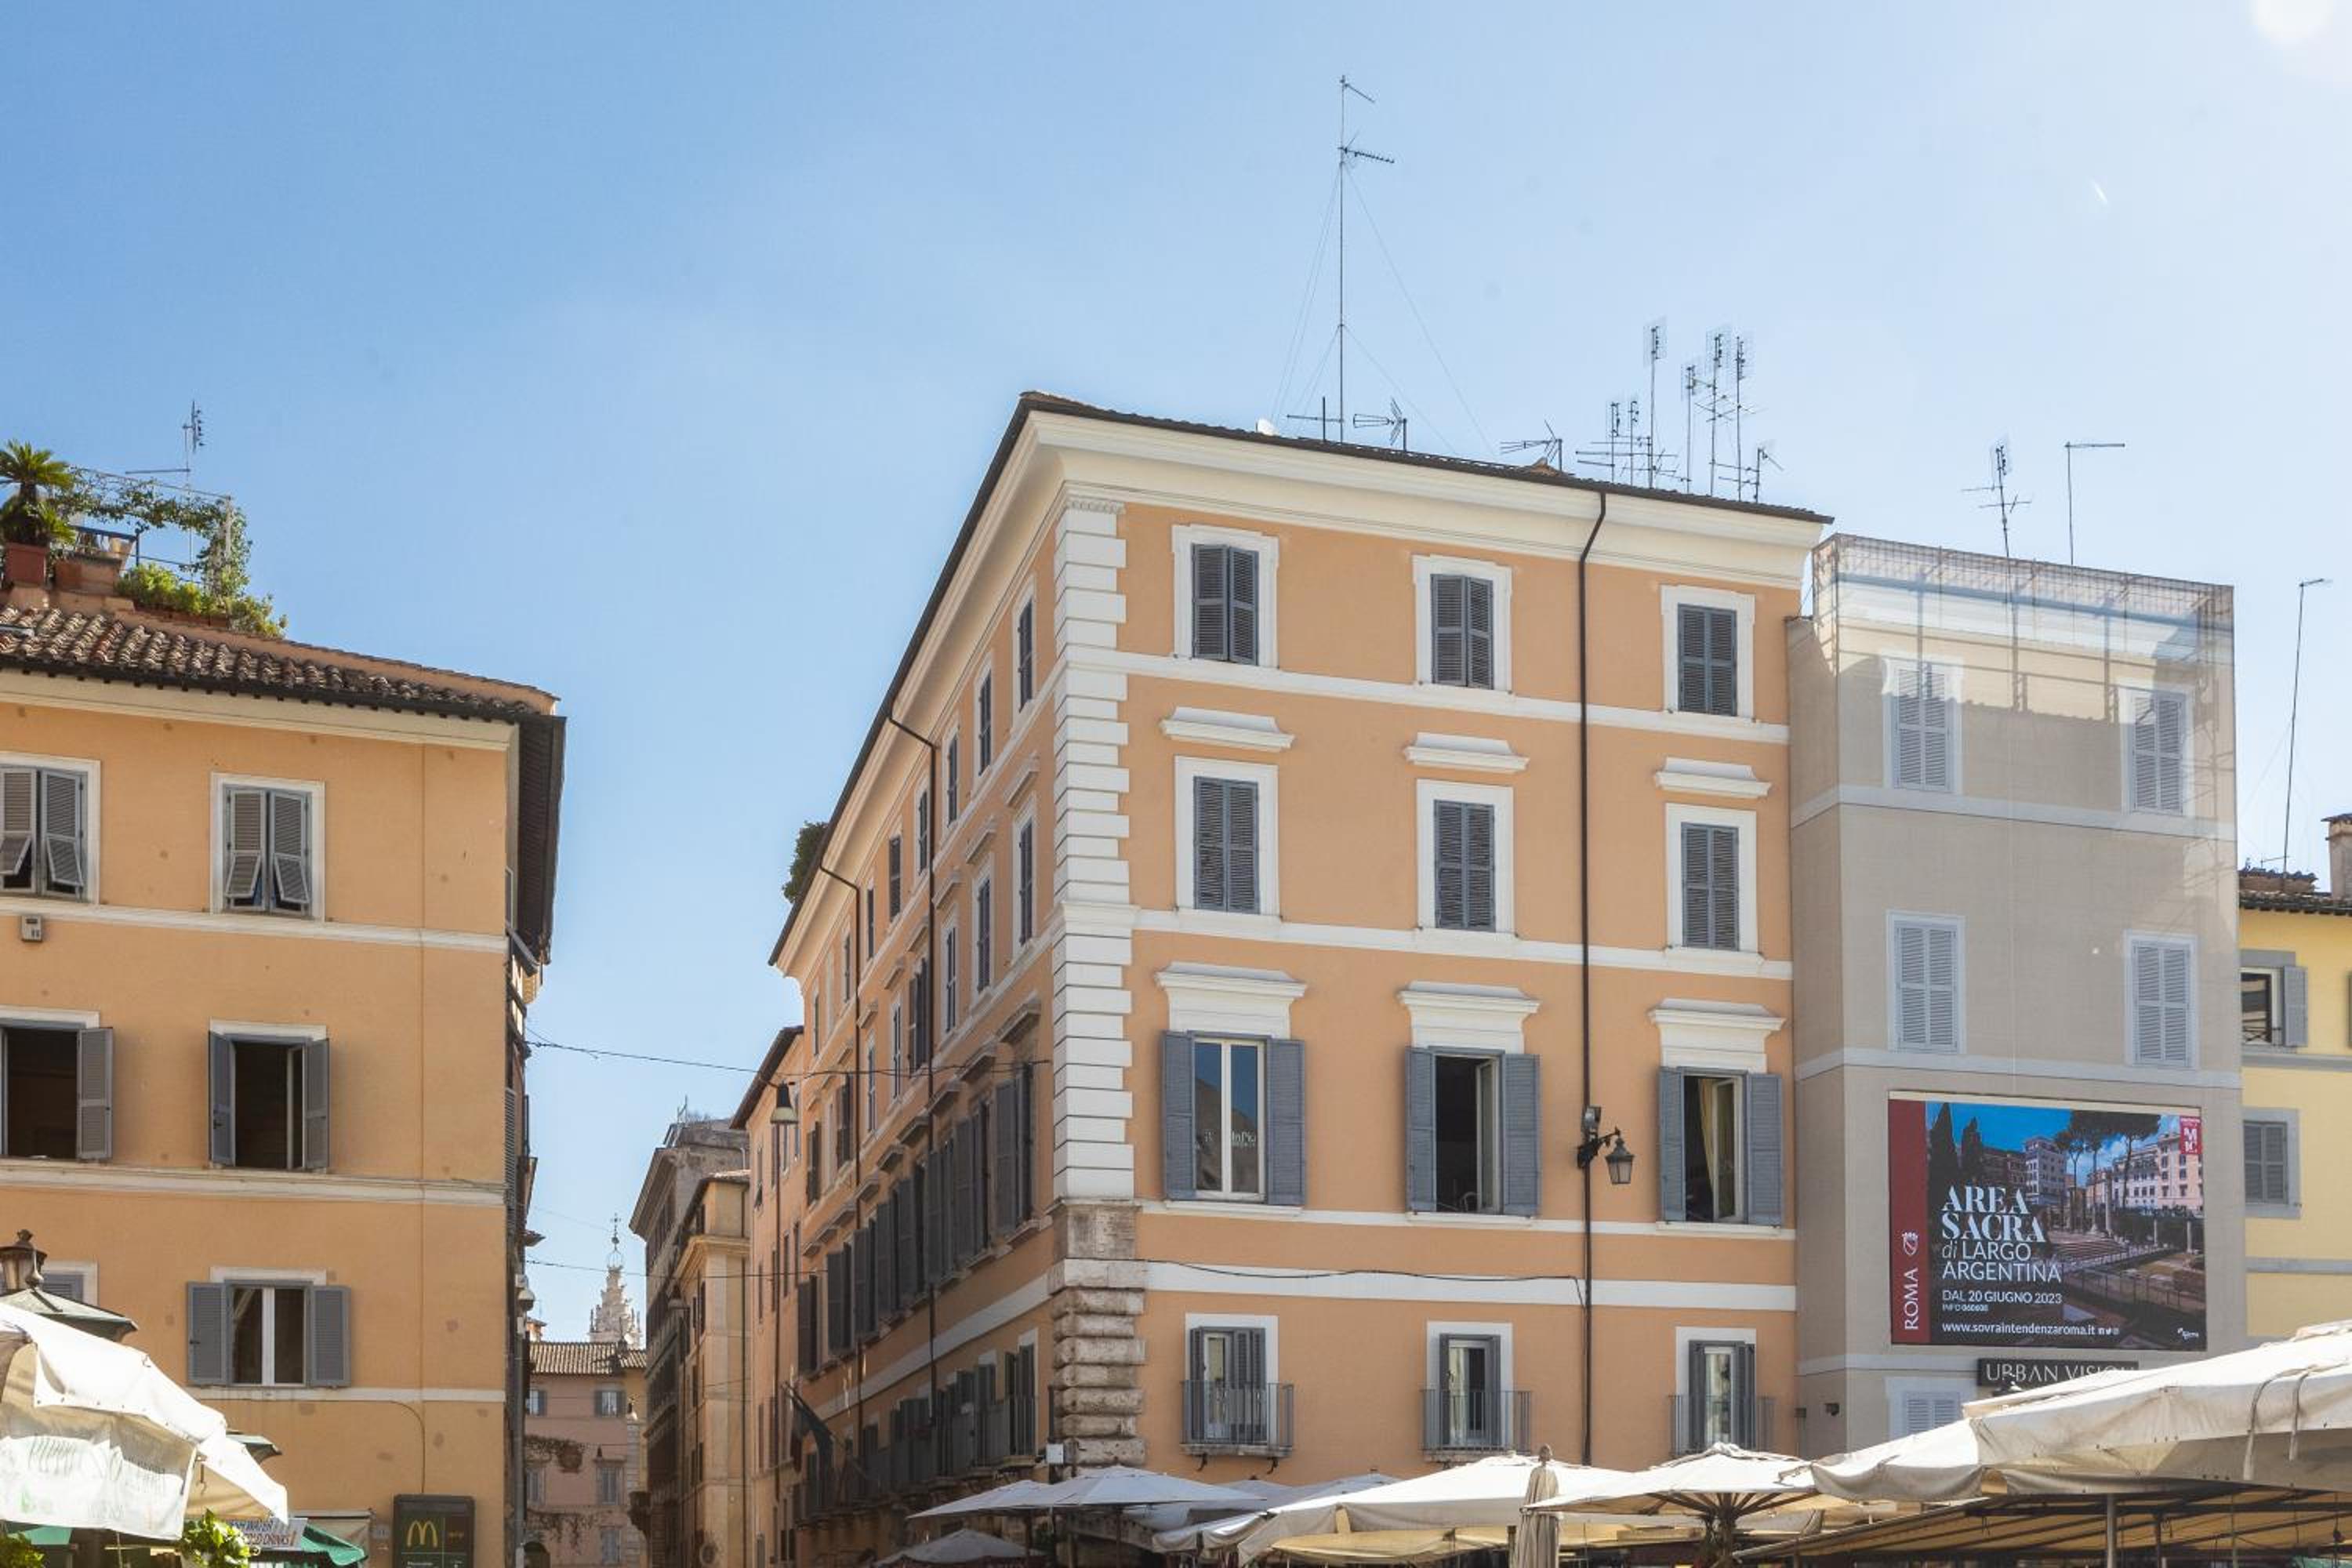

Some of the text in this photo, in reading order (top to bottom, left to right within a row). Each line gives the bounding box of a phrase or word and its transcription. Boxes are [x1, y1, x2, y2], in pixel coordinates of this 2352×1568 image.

[1941, 1185, 2030, 1214] AREA
[1941, 1212, 2046, 1243] SACRA
[1942, 1241, 2032, 1261] di LARGO
[1942, 1261, 2063, 1283] ARGENTINA
[1904, 1268, 1919, 1330] ROMA
[1942, 1290, 2063, 1305] DAL 20 GIUGNO 2023
[1942, 1322, 2096, 1336] www.sovraintendenzaroma.it
[1986, 1363, 2059, 1383] URBAN
